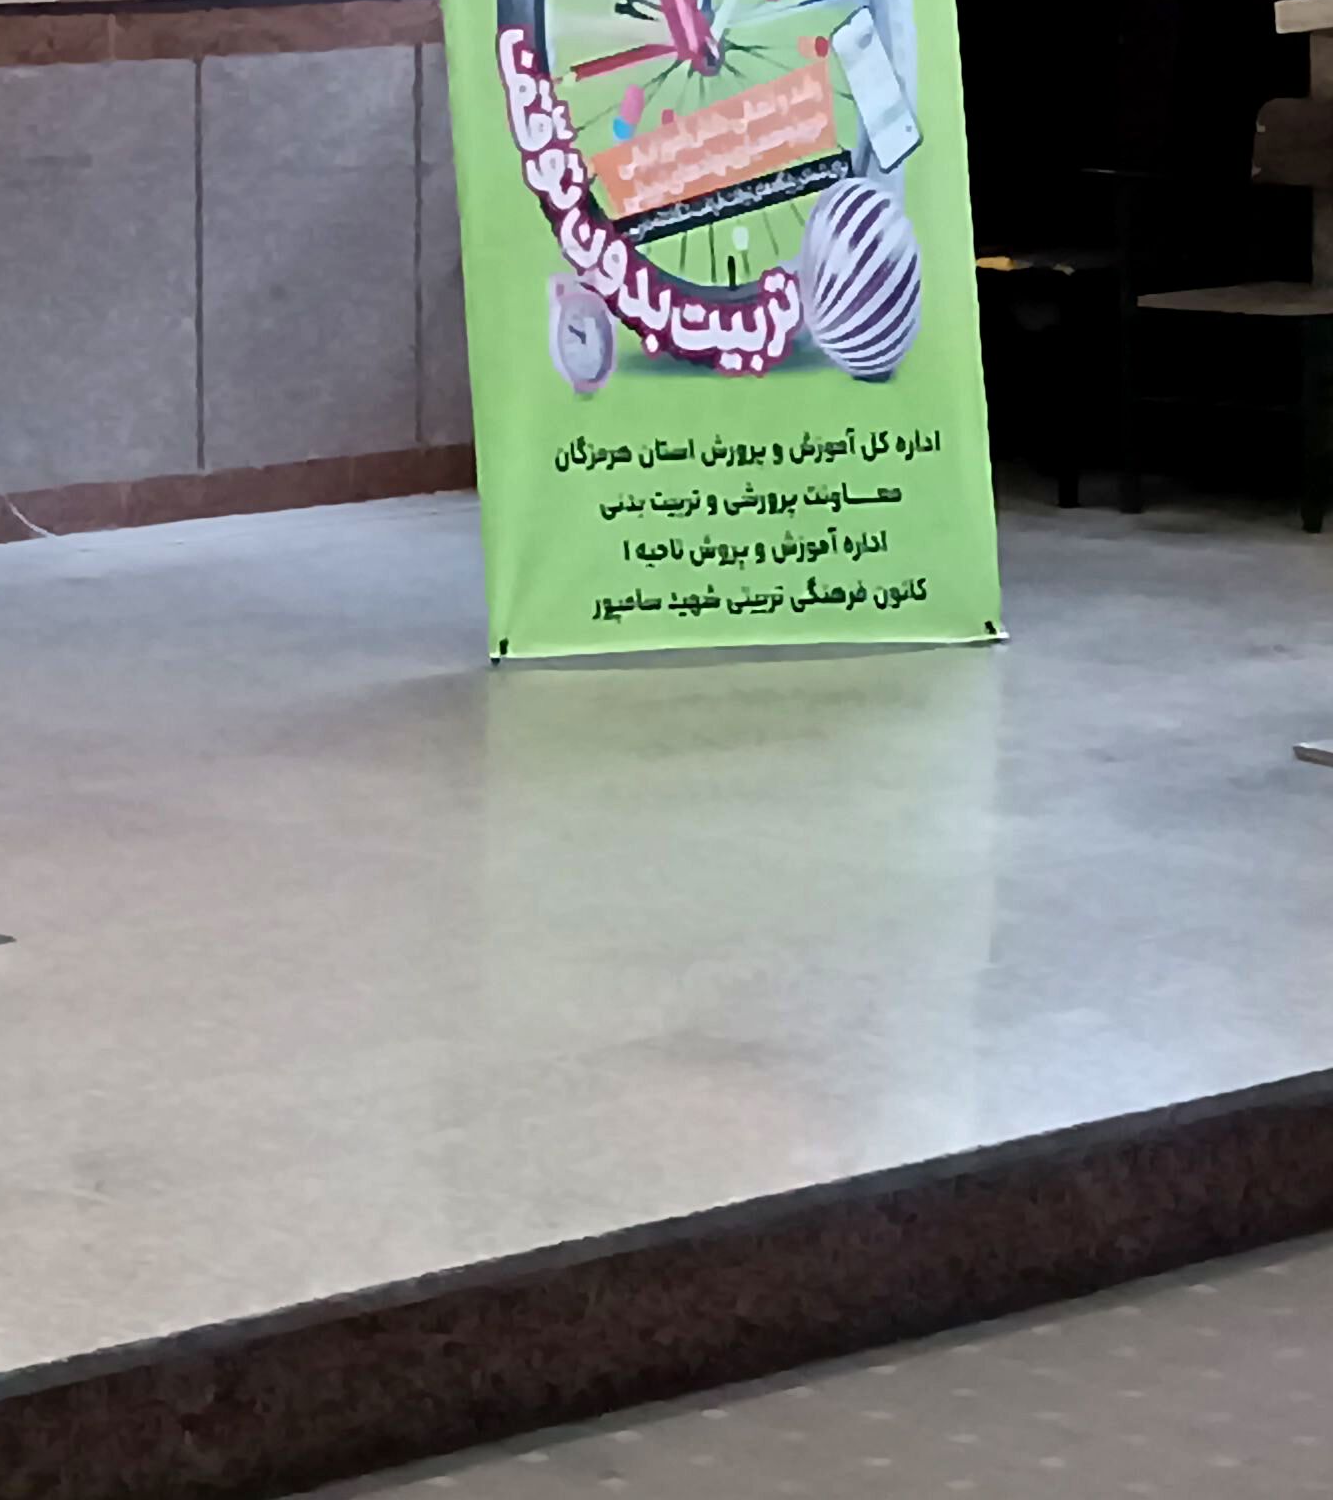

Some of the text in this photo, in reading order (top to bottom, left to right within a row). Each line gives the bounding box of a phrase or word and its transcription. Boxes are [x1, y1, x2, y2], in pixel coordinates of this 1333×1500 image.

[559, 207, 672, 353] بدون
[670, 272, 801, 372] تربیت
[555, 427, 940, 472] اداره کل آموزش و پرورش استان هرمزگان
[599, 481, 902, 521] معاونت پرورشی و تربیت بدنی
[635, 538, 684, 568] ناحیه
[754, 542, 766, 564] و
[771, 526, 838, 564] آموزش
[843, 530, 888, 562] اداره
[668, 583, 722, 617] شهید
[727, 585, 784, 615] تربیتی
[789, 576, 867, 613] فرهنگی
[873, 577, 927, 610] کانون
